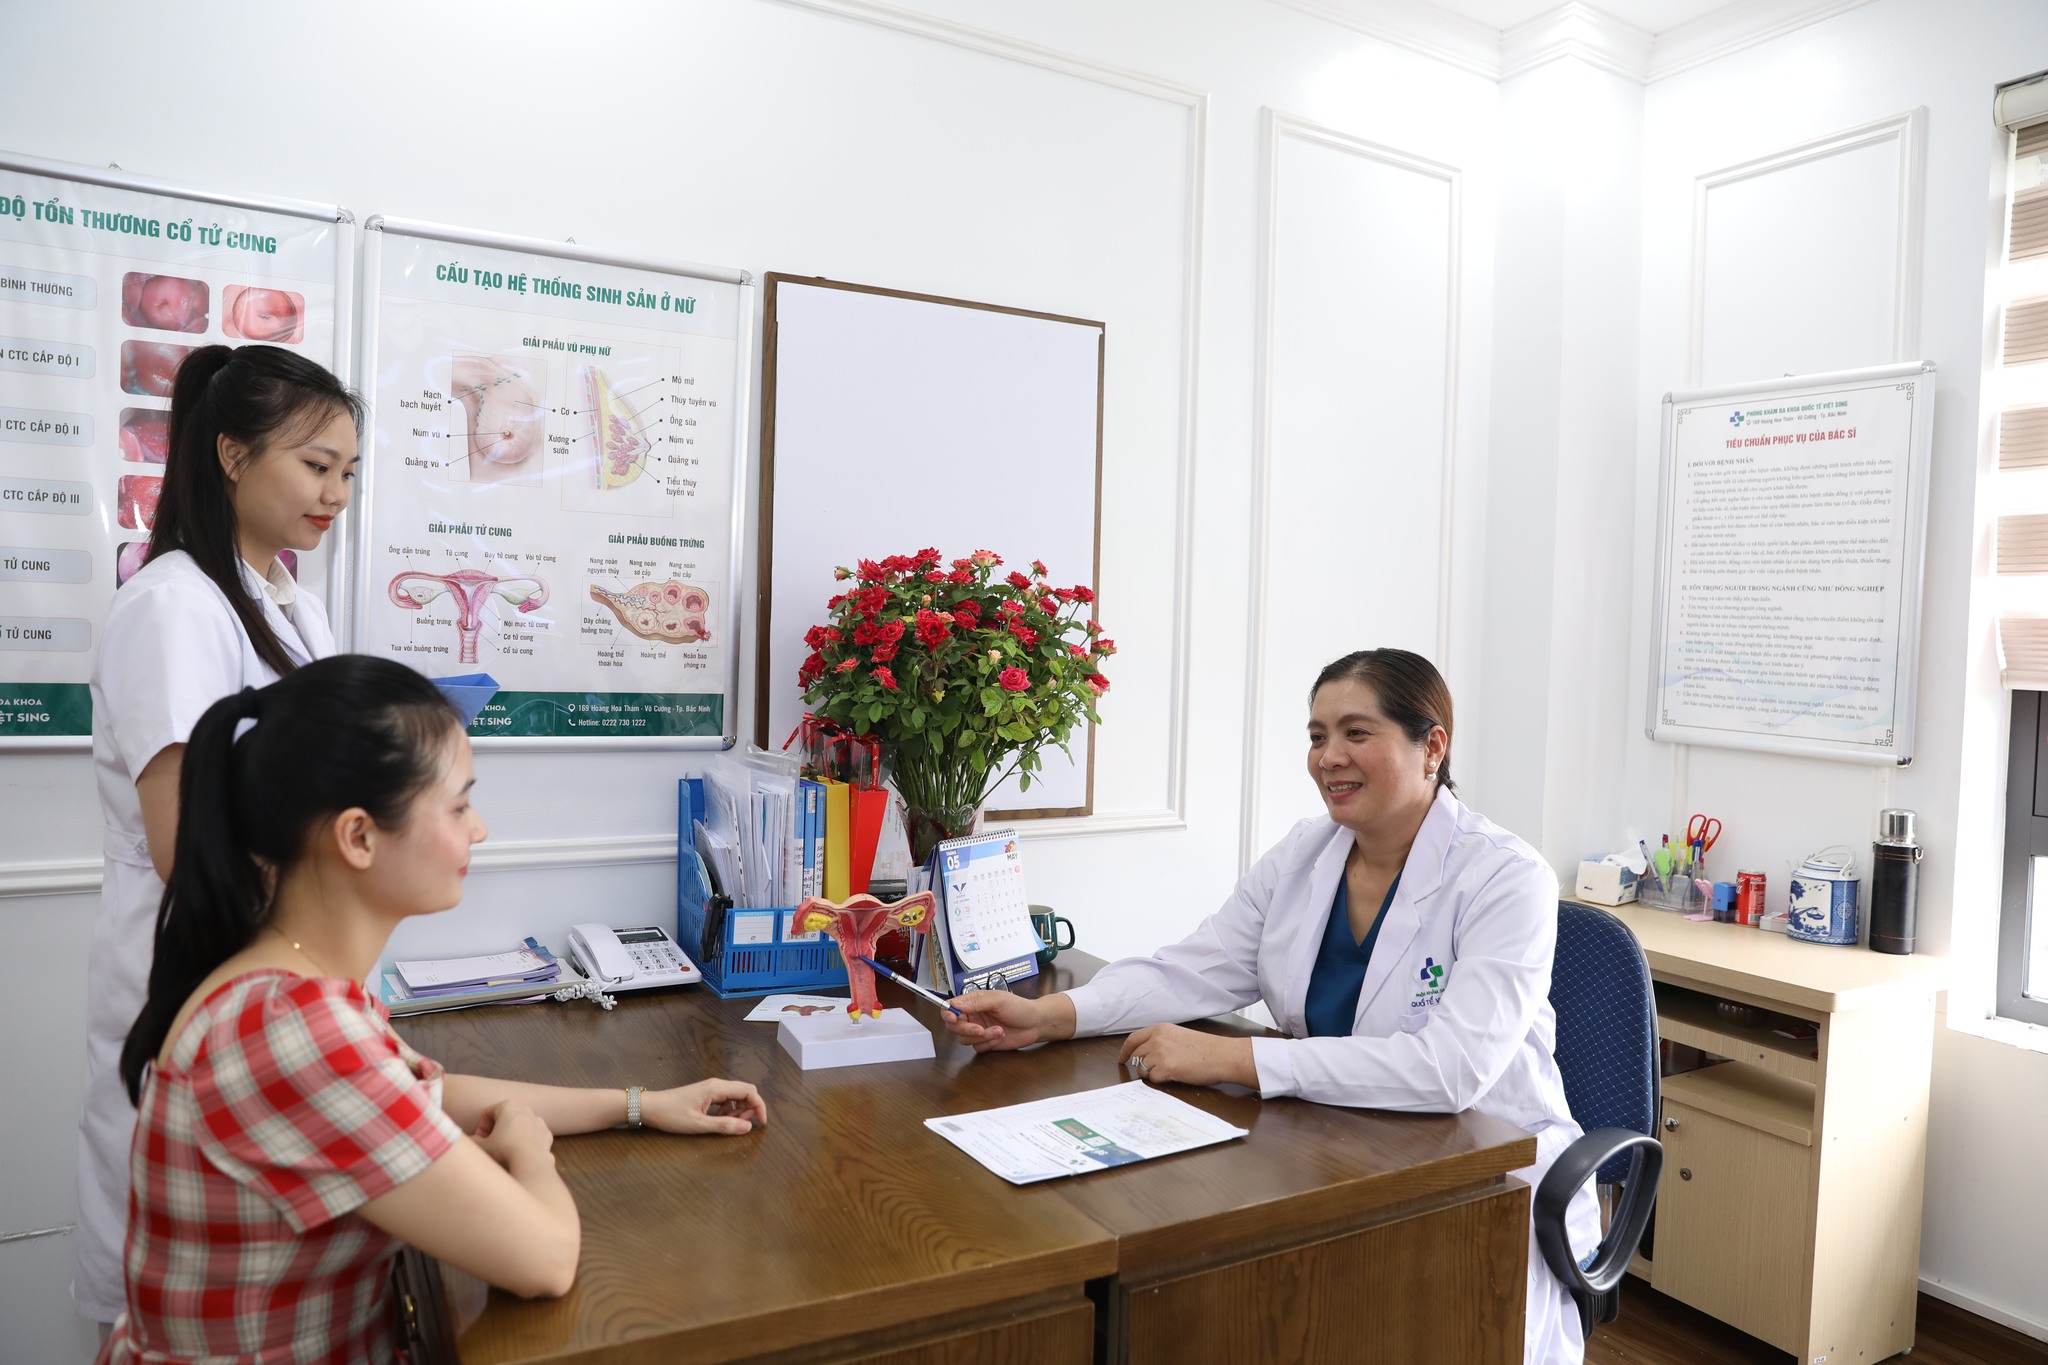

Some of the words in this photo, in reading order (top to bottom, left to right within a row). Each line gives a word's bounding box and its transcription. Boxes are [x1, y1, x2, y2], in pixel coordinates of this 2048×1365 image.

[0, 195, 26, 222] ĐỘ
[33, 197, 74, 225] TỔN
[81, 209, 160, 238] THƯƠNG
[167, 218, 192, 242] CỔ
[198, 223, 223, 246] TỬ
[227, 231, 277, 254] CUNG
[0, 277, 26, 290] BÌNH
[30, 281, 73, 297] THƯỜNG
[436, 261, 469, 284] CẤU
[474, 269, 503, 290] TẠO
[508, 273, 527, 295] HỆ
[532, 276, 581, 300] THỐNG
[586, 285, 622, 305] SINH
[626, 288, 657, 309] SẢN
[660, 291, 671, 311] Ở
[675, 296, 696, 314] NỮ
[8, 349, 28, 361] CTC
[33, 350, 54, 363] CẤP
[57, 353, 72, 367] ĐỘ
[76, 357, 79, 366] I
[6, 420, 26, 431] CTC
[30, 419, 51, 432] CẤP
[55, 423, 69, 436] ĐỘ
[73, 425, 79, 435] II
[3, 490, 23, 501] CTC
[28, 489, 48, 502] CẤP
[53, 491, 66, 505] ĐỘ
[70, 494, 80, 504] III
[4, 556, 17, 570] TỬ
[22, 560, 50, 571] CUNG
[6, 626, 19, 639] TỬ
[23, 629, 52, 640] CUNG
[13, 698, 42, 706] KHOA
[17, 712, 51, 722] SING
[487, 717, 512, 726] SING
[947, 854, 960, 870] 05
